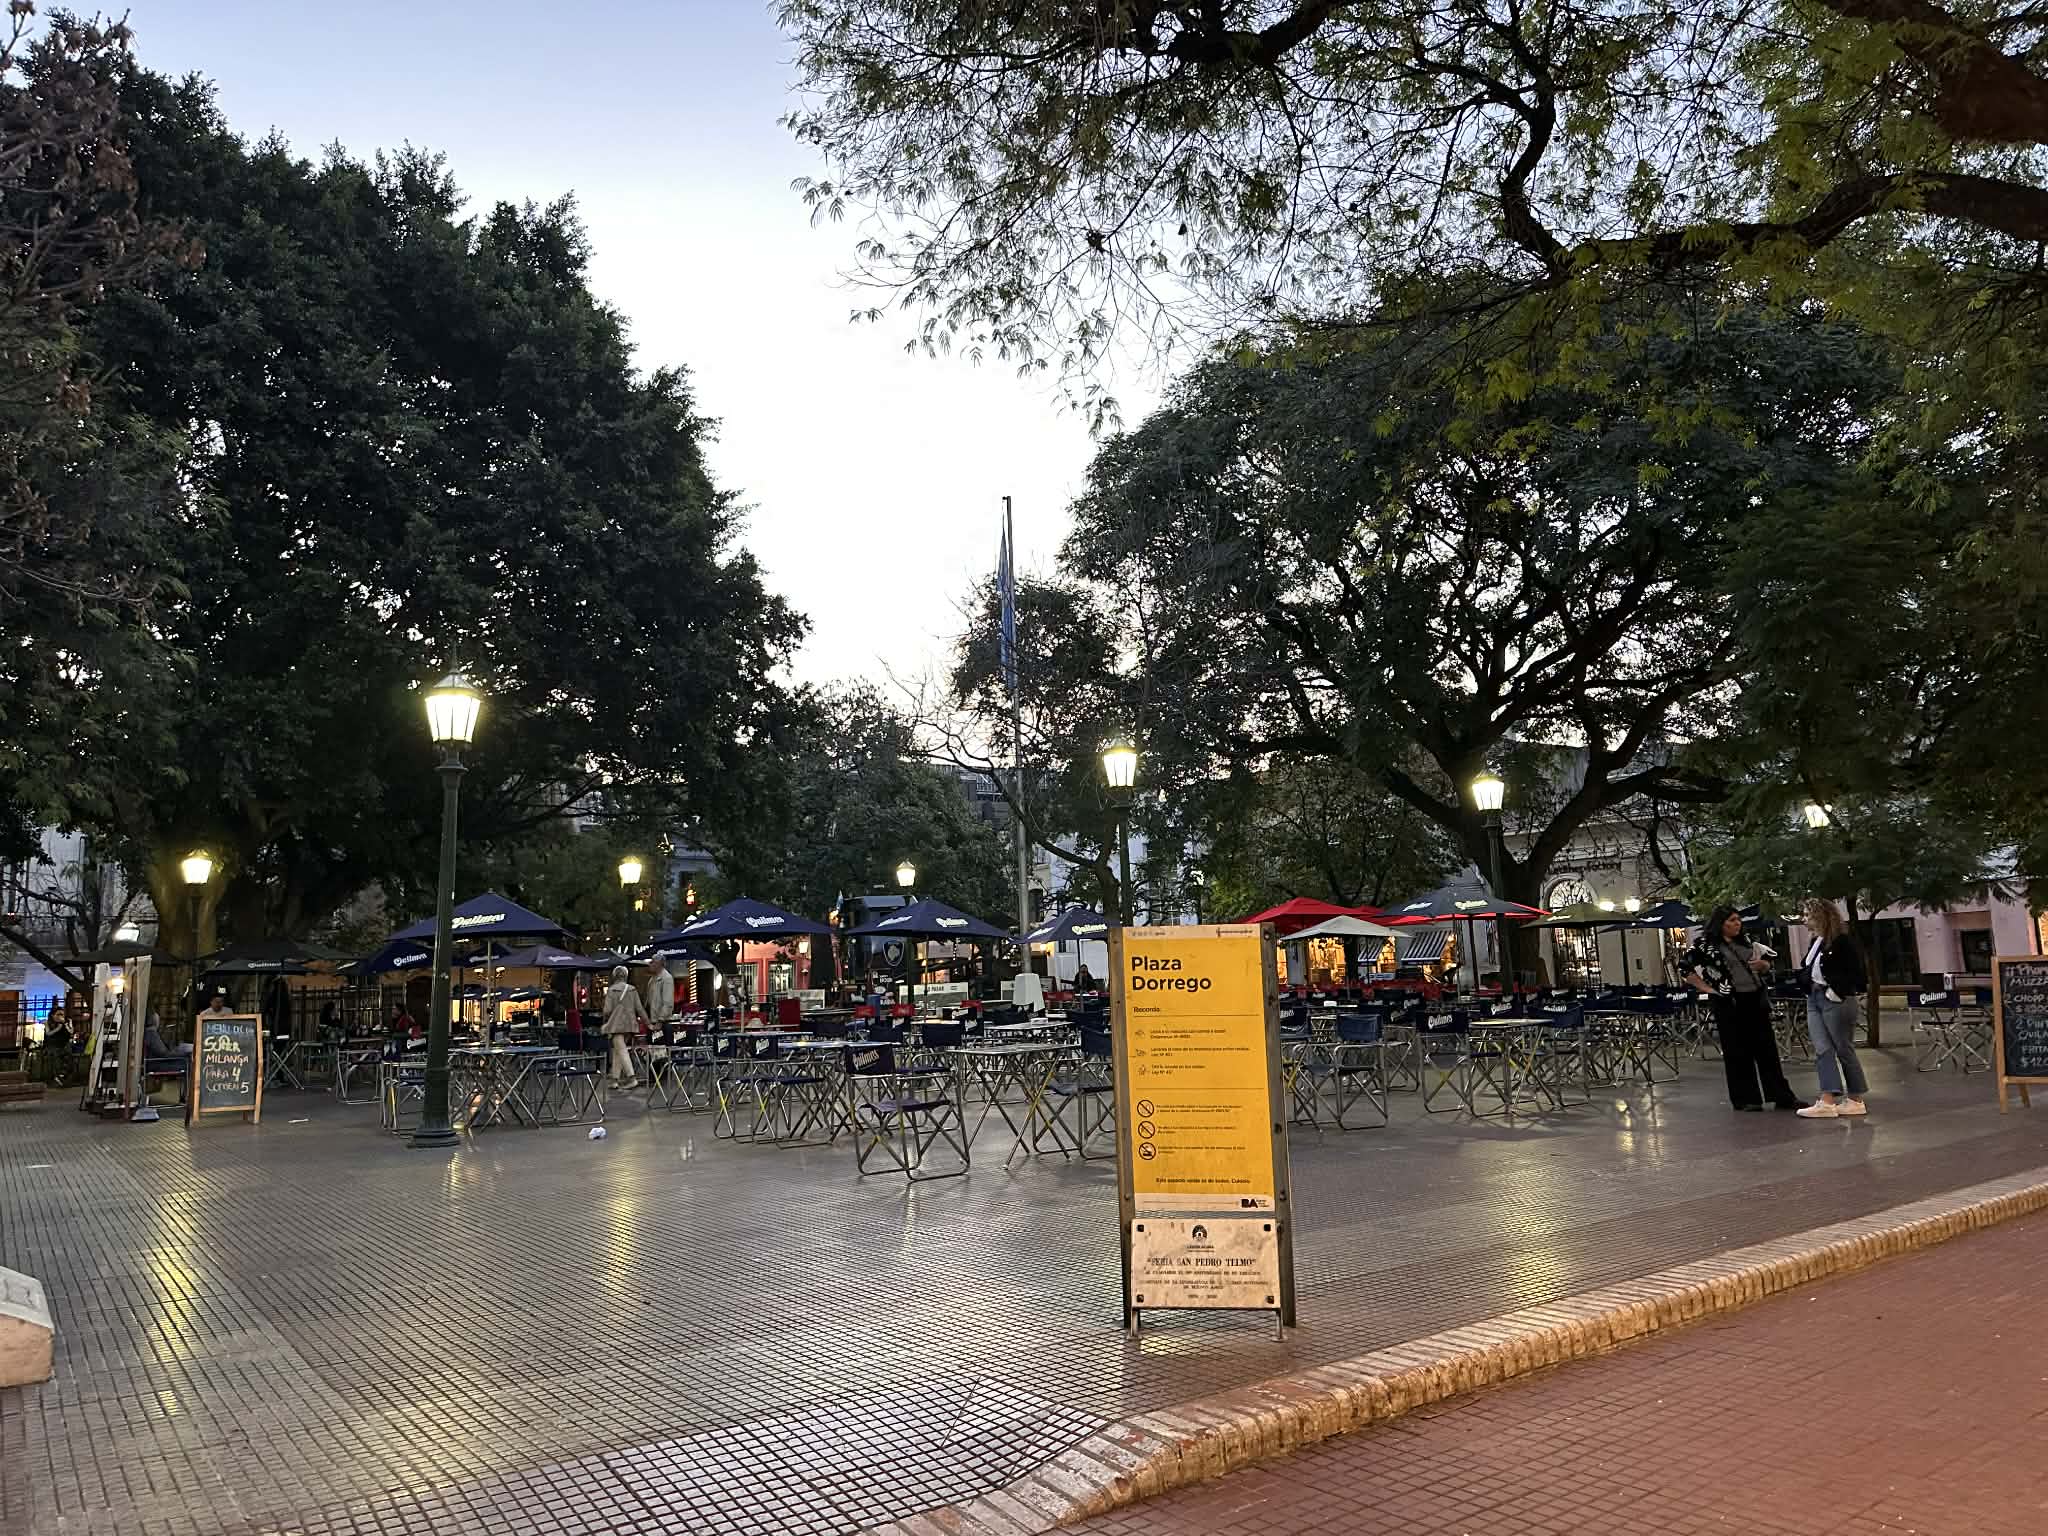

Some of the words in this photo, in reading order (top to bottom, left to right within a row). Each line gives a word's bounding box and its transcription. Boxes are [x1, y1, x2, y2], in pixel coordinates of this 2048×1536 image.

[1131, 956, 1182, 971] Plaza
[1132, 976, 1212, 992] Dorrego
[203, 1035, 241, 1052] SUPER
[205, 1054, 249, 1066] MILANGA
[852, 1047, 880, 1071] Quilmes
[232, 1066, 241, 1082] 4
[240, 1081, 249, 1094] 5
[1241, 1198, 1259, 1209] BA
[1195, 1258, 1222, 1267] PEDRO
